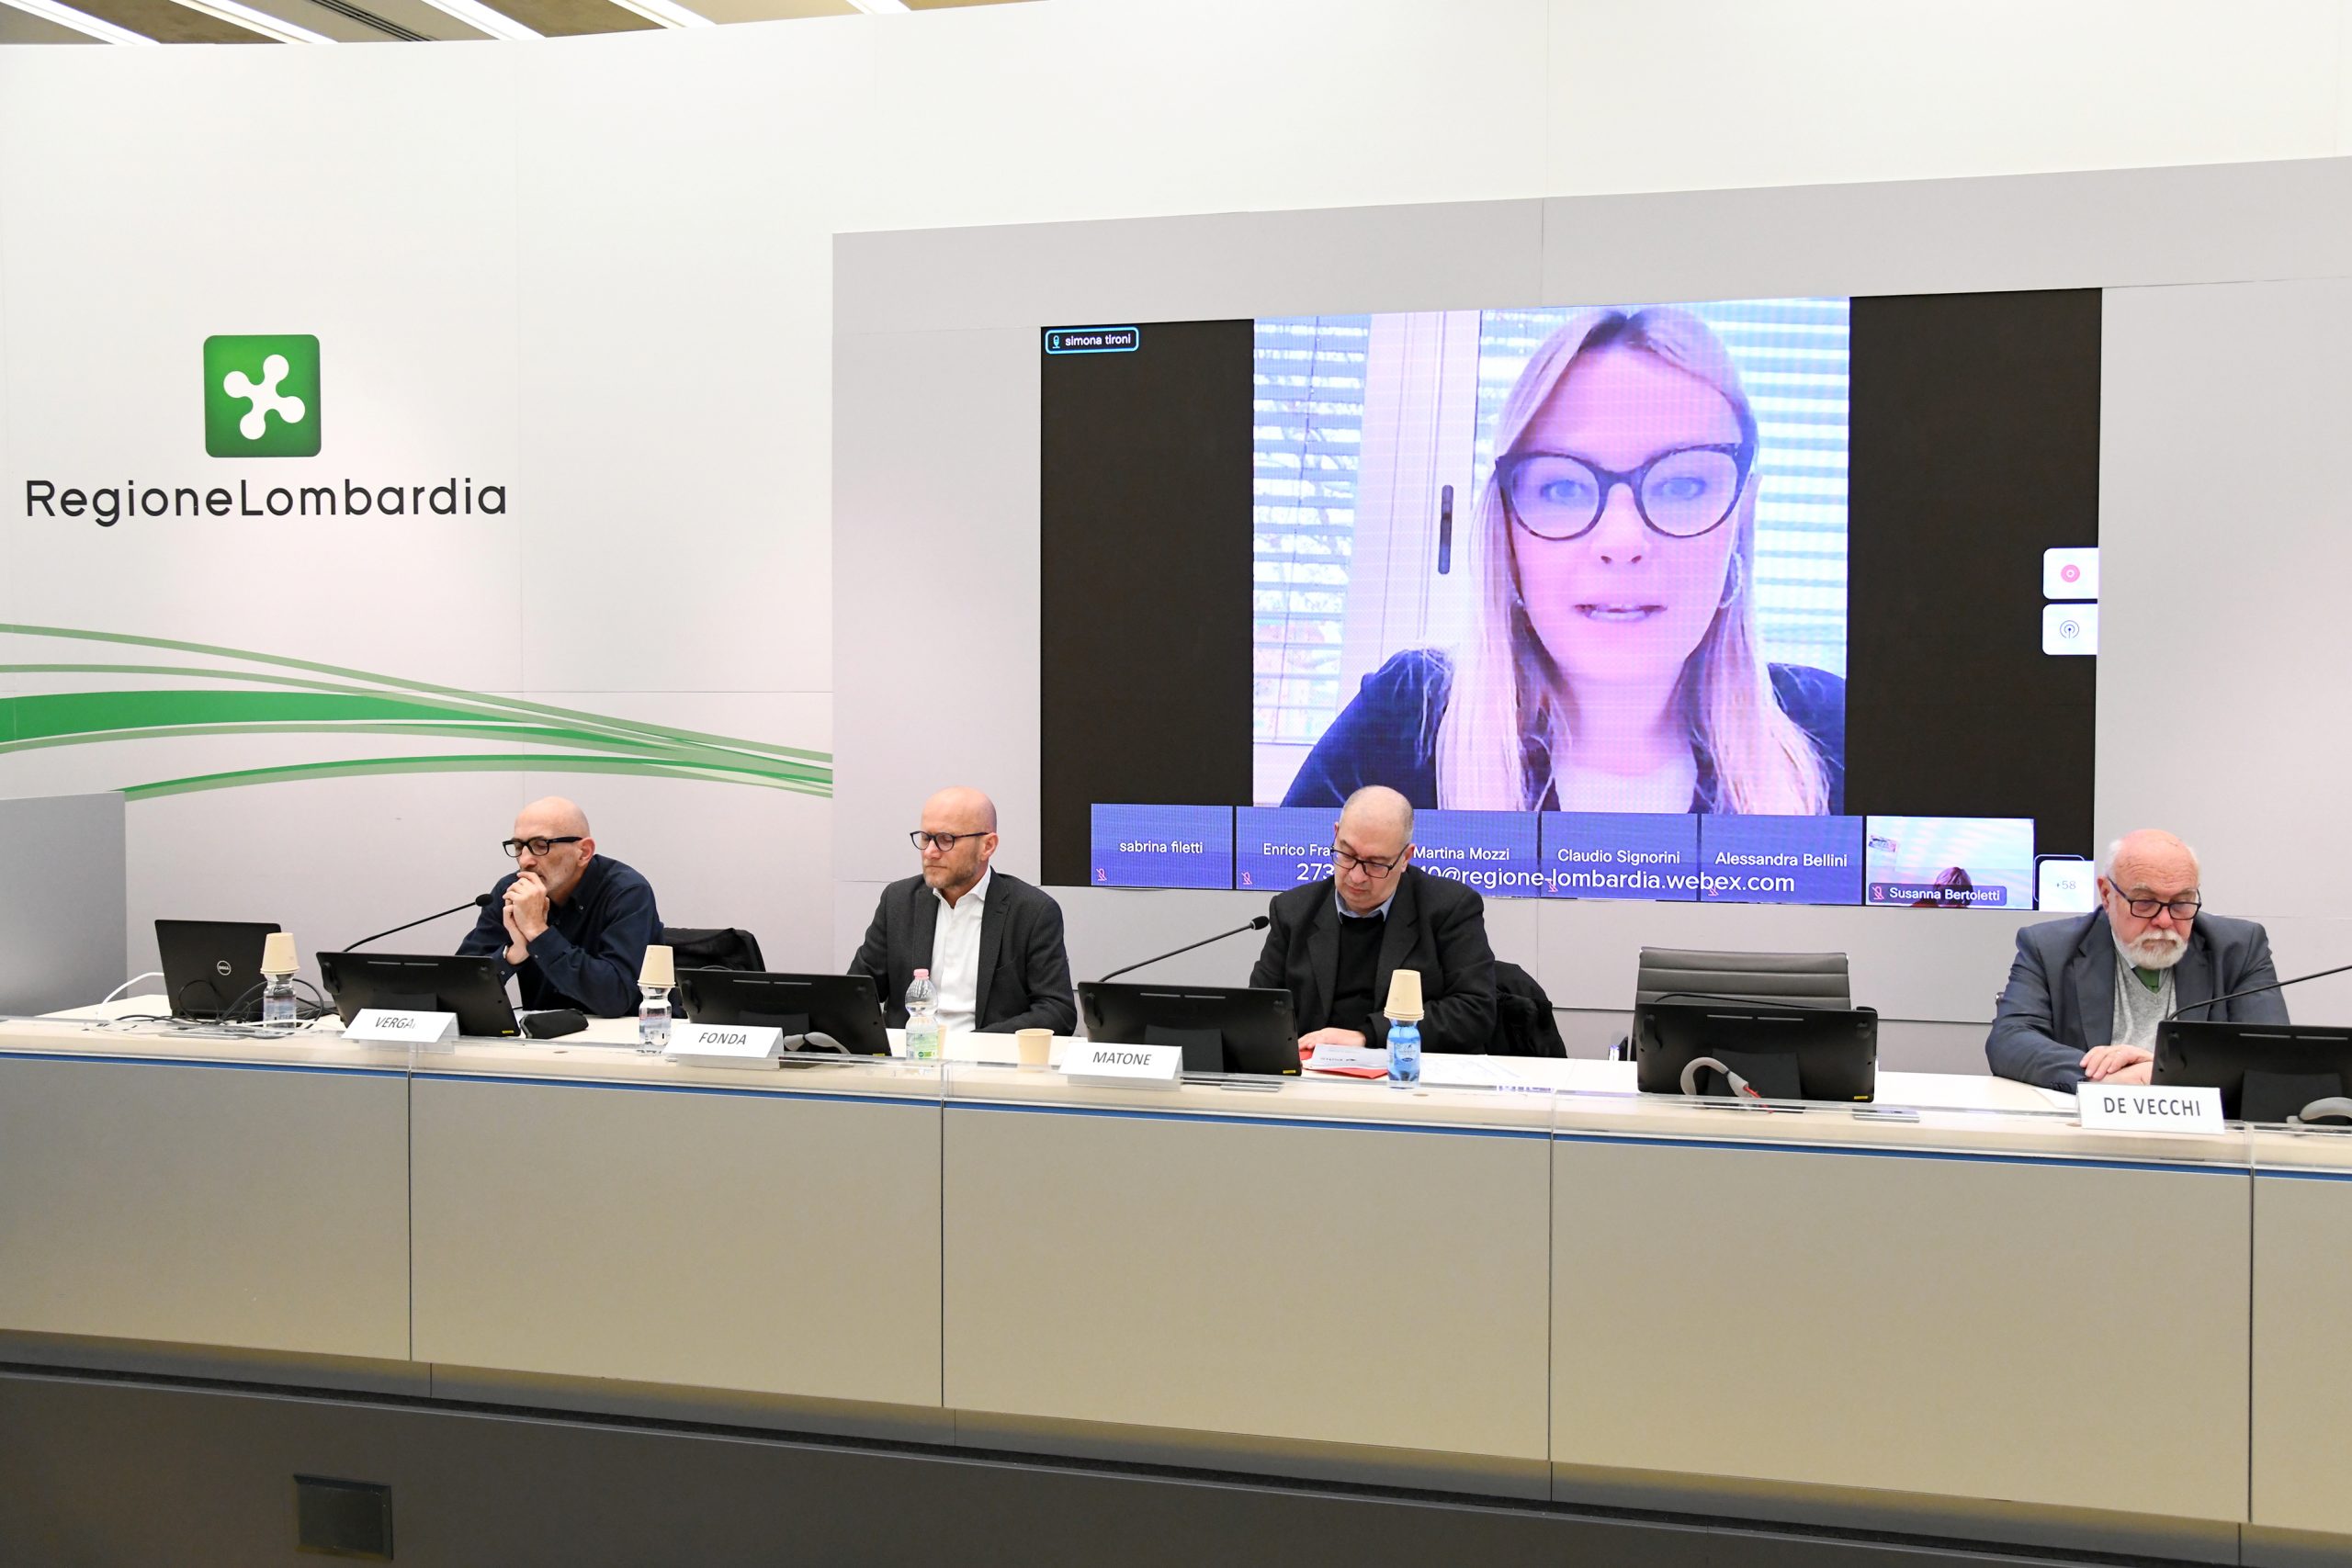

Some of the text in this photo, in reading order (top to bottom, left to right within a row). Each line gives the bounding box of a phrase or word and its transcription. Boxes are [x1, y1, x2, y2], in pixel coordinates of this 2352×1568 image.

[1065, 333, 1131, 346] simona tironi
[26, 478, 507, 526] RegioneLombardia
[1119, 840, 1203, 853] sabrina filetti
[1263, 842, 1332, 856] Enrico Fra
[1413, 846, 1510, 861] Martina Mozzi
[1557, 849, 1680, 865] Claudio Signorini
[1714, 852, 1848, 867] Alessandra Bellini
[1889, 887, 2000, 901] Susanna Bertoletti
[698, 1032, 747, 1045] FONDA
[1092, 1051, 1152, 1066] MATONE
[2103, 1097, 2200, 1117] DE VECCHI
